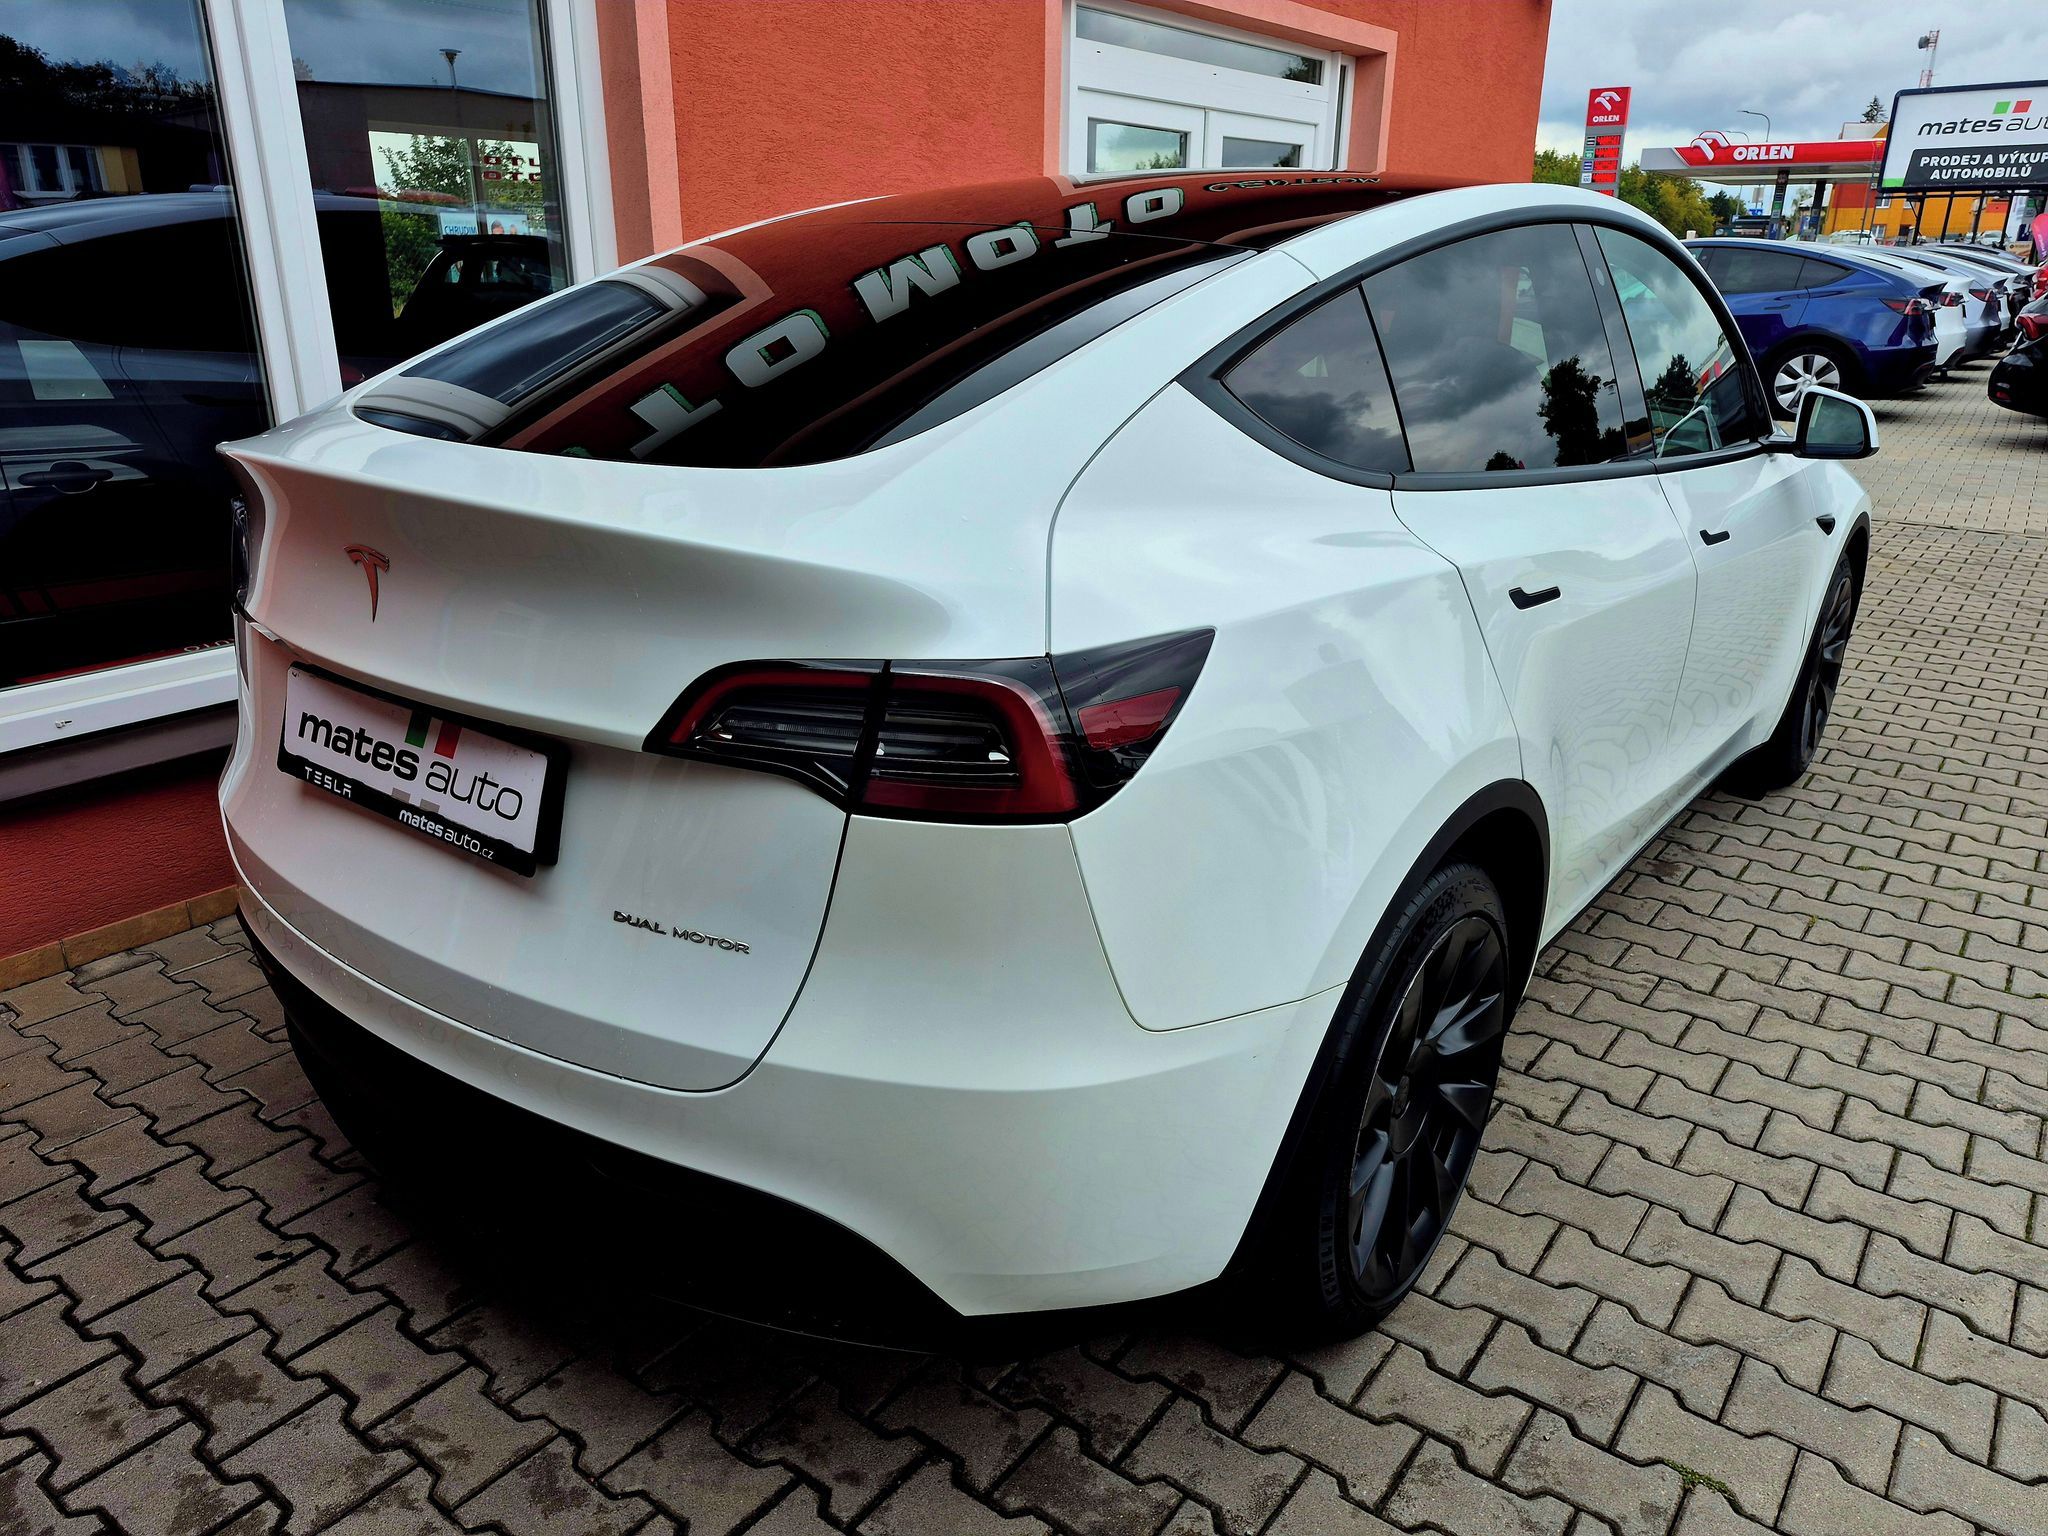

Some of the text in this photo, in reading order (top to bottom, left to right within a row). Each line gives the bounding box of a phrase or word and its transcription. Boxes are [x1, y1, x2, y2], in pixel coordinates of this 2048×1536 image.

[1592, 114, 1620, 123] ORLEN
[1918, 118, 2003, 135] mates
[1733, 145, 1795, 161] ORLEN
[1920, 154, 1981, 167] PRODEJ
[1983, 154, 1993, 165] A
[298, 711, 523, 821] mates auto
[304, 766, 352, 798] TESLA
[613, 910, 750, 955] DUAL MOTOR
